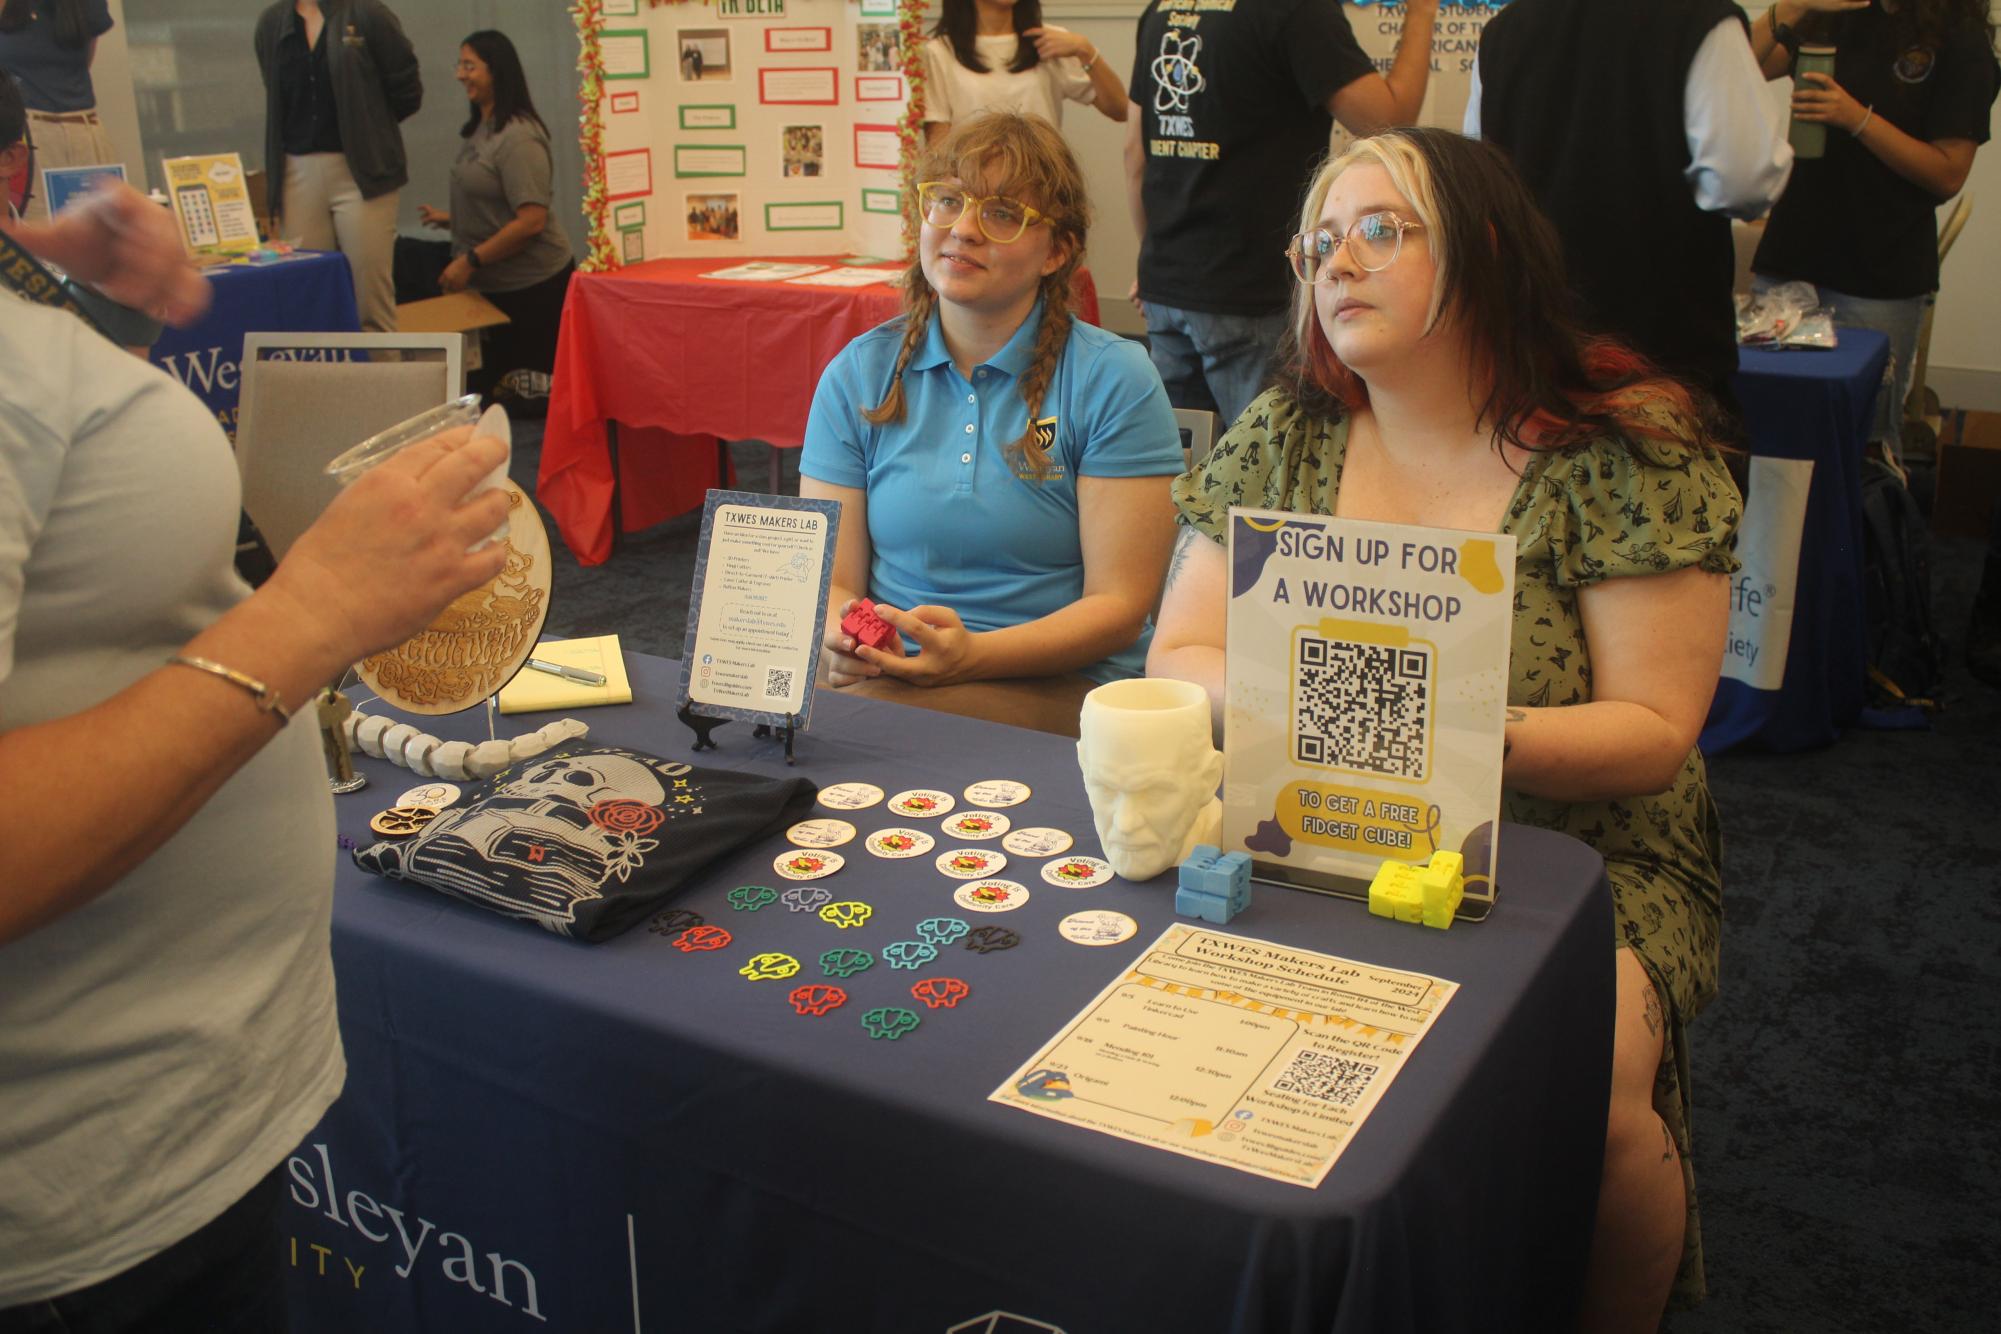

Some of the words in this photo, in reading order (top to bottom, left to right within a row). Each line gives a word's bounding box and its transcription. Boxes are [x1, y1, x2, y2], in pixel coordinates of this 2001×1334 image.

[1447, 23, 1467, 35] OF
[1158, 115, 1194, 138] TXWES
[726, 511, 757, 524] TXWES
[760, 515, 797, 528] MAKERS
[800, 519, 818, 530] LAB
[1279, 530, 1344, 563] SIGN
[1356, 538, 1390, 567] UP
[1401, 543, 1457, 575] FOR
[1273, 578, 1290, 604] A
[1303, 580, 1462, 623] WORKSHOP
[1728, 631, 1760, 667] iety
[911, 791, 938, 801] Voting
[1298, 789, 1321, 808] TO
[1325, 795, 1359, 815] GET
[1363, 802, 1376, 817] A
[1380, 803, 1419, 825] FREE
[962, 812, 993, 820] Voting
[898, 829, 923, 841] Voting
[1302, 816, 1359, 841] FIDGET
[1363, 827, 1412, 850] CUBE!
[802, 851, 830, 861] Voting
[957, 850, 988, 858] Voting
[1069, 857, 1099, 866] Voting
[980, 880, 1012, 889] Voting
[1196, 946, 1274, 969] Workshop
[1276, 965, 1349, 984] Schedule
[1201, 938, 1261, 955] TXWES
[1264, 951, 1324, 970] Makers
[1330, 966, 1360, 977] Lab
[1369, 975, 1422, 990] September
[1391, 987, 1419, 997] 2024
[1304, 1029, 1329, 1039] Scan
[1331, 1035, 1350, 1044] the
[1352, 1040, 1371, 1048] QR
[1373, 1045, 1403, 1055] Code
[1326, 1044, 1380, 1060] Register!
[1264, 1089, 1301, 1104] Seating
[1246, 1095, 1301, 1114] Workshop
[1312, 1111, 1354, 1127] Limited
[288, 1143, 548, 1322] sleyan
